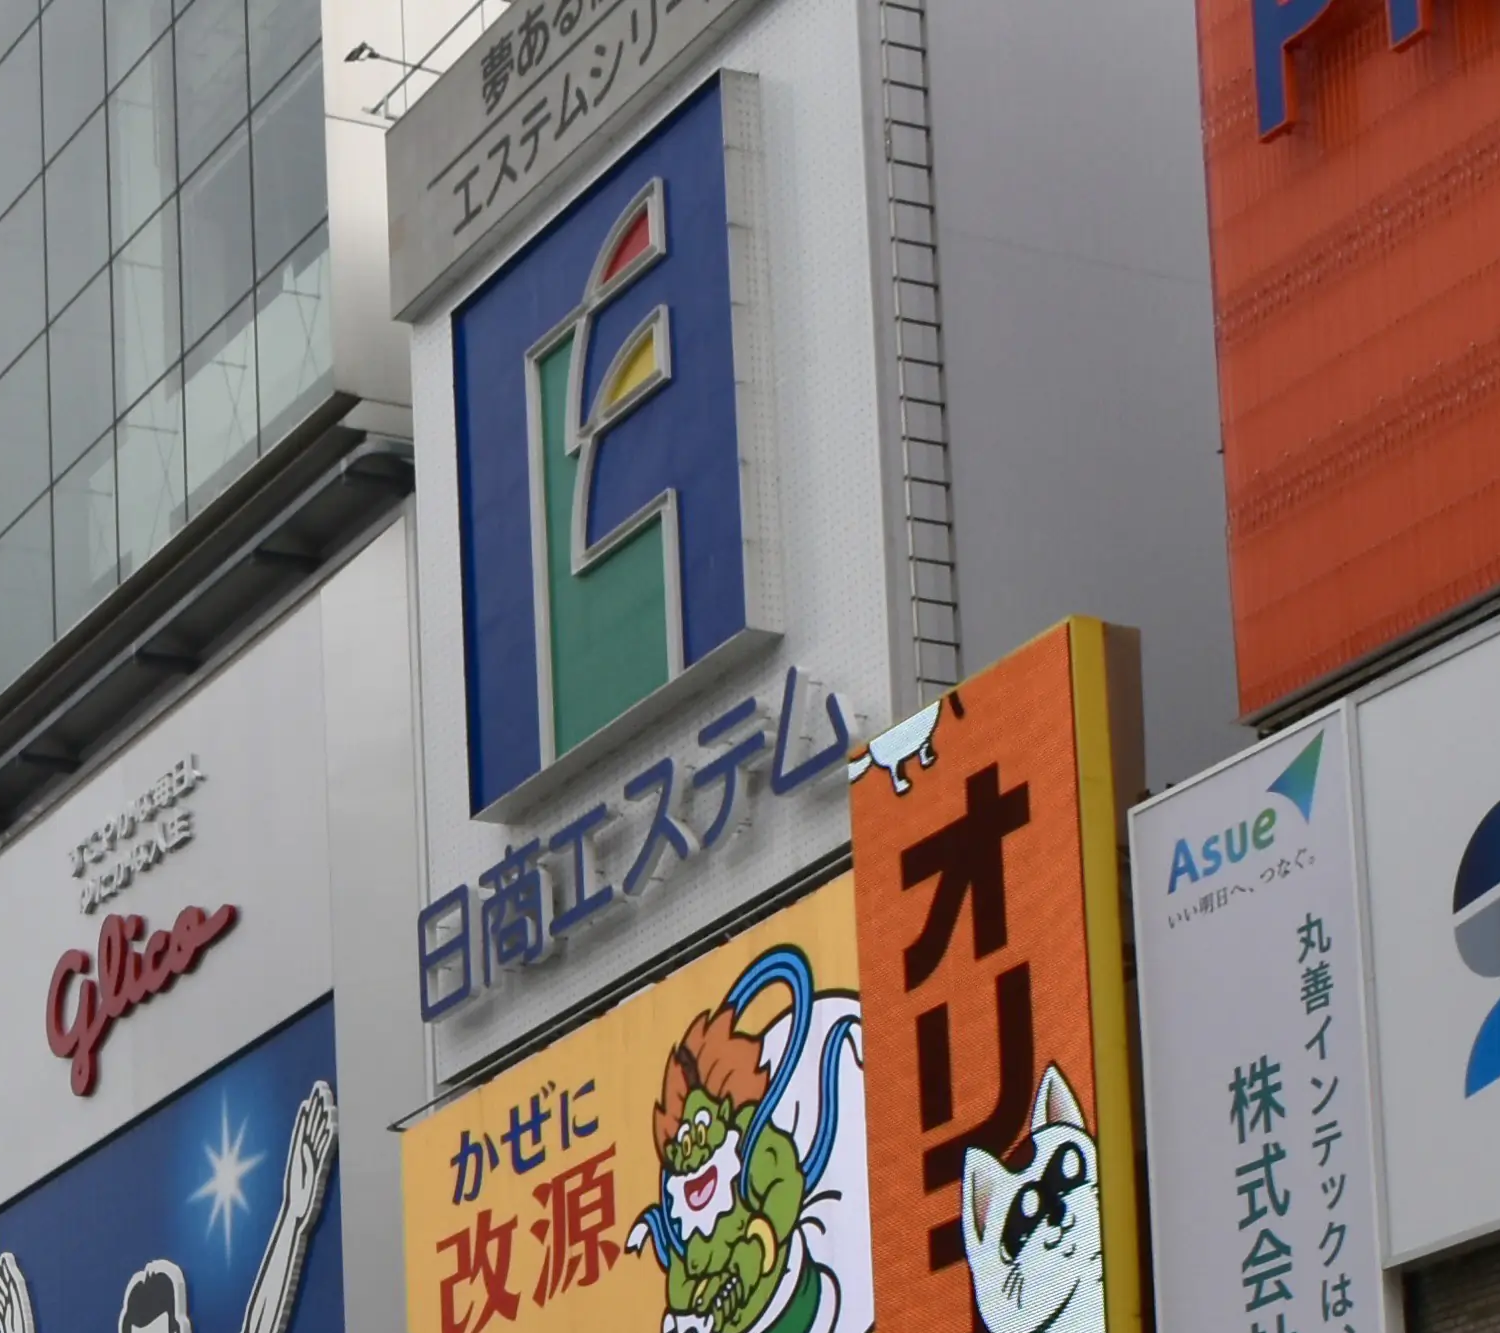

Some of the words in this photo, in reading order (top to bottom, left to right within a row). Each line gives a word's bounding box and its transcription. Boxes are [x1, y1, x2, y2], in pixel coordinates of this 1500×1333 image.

[417, 666, 850, 1022] 日商エステム
[1166, 807, 1276, 894] Asue
[1166, 848, 1318, 929] いい明日へ、つなぐ。
[45, 904, 238, 1097] Glico
[450, 1078, 600, 1206] かぜに
